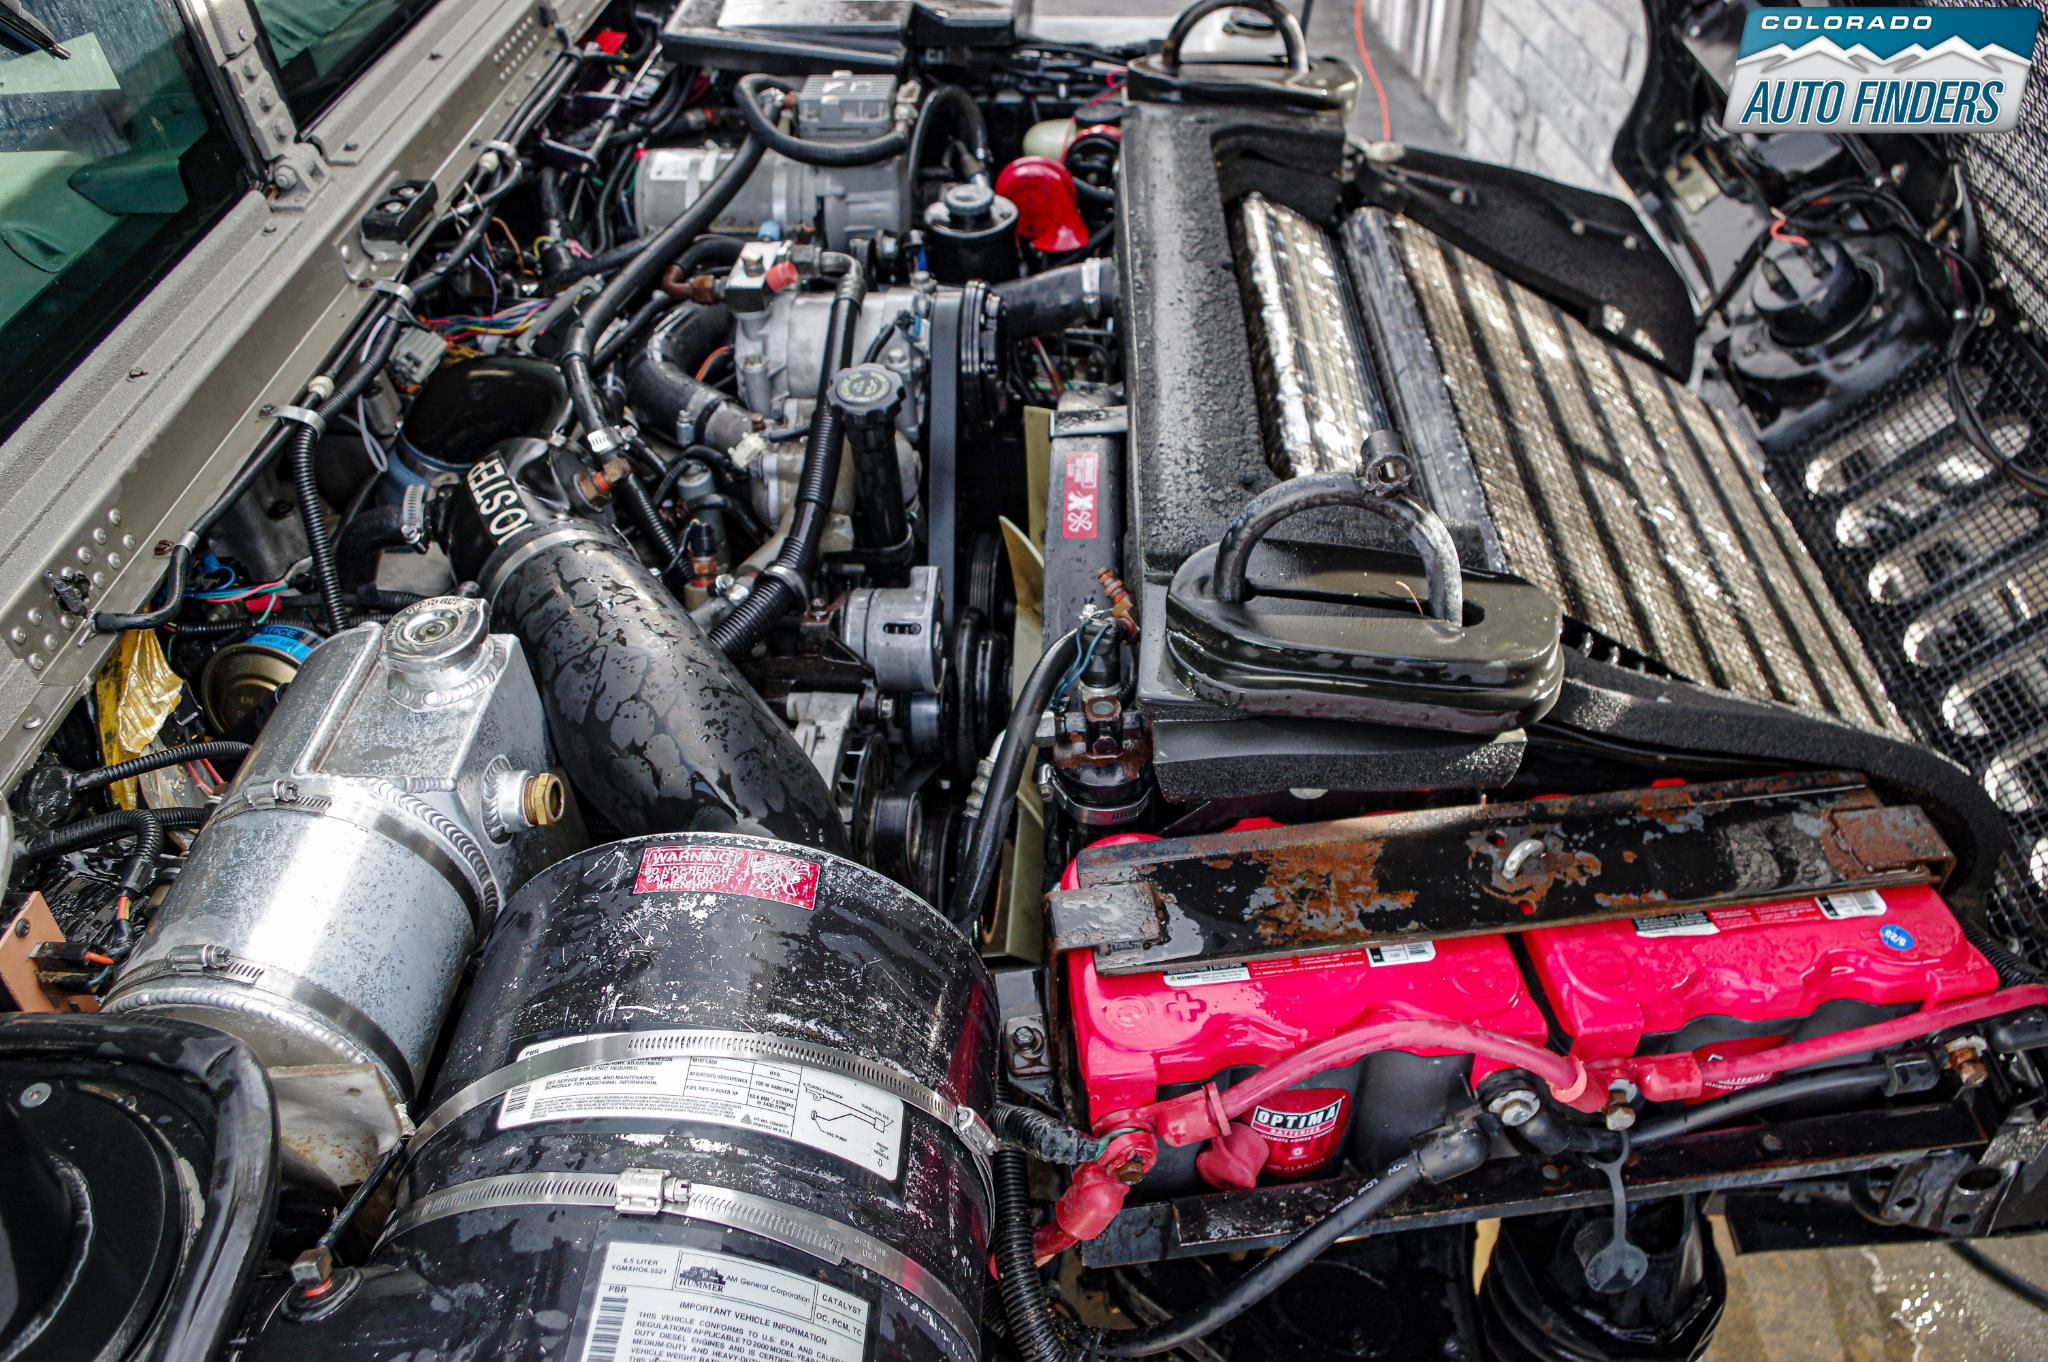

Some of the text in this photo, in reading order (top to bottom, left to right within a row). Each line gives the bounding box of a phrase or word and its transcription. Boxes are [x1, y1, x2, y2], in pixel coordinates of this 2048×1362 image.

[646, 873, 668, 884] CAP
[1257, 1106, 1336, 1129] OPTIMA
[636, 1258, 659, 1266] LITER
[608, 1285, 627, 1293] PBR
[680, 1278, 724, 1293] HUMMER
[725, 1275, 811, 1304] AM General Corporation
[822, 1293, 862, 1316] CATALYST
[636, 1320, 692, 1334] REGULATIONS
[693, 1328, 740, 1344] APPLICABLE
[742, 1337, 752, 1346] TO
[753, 1340, 769, 1351] 2000
[639, 1311, 657, 1320] THIS
[661, 1314, 696, 1325] VEHICLE
[699, 1320, 744, 1335] CONFORMS
[748, 1330, 759, 1338] TO
[780, 1339, 795, 1349] EPA
[798, 1345, 813, 1355] AND
[680, 1301, 828, 1347] IMPORTANT VEHICLE INFORMATION
[816, 1312, 863, 1337] OC, PCM, TC
[631, 1347, 665, 1357] VEHICLE
[632, 1338, 688, 1351] MEDIUM-DUTY
[692, 1346, 709, 1355] AND
[634, 1328, 656, 1338] DUTY
[659, 1332, 686, 1342] DIESEL
[691, 1336, 725, 1349] ENGINES
[729, 1344, 745, 1354] AND
